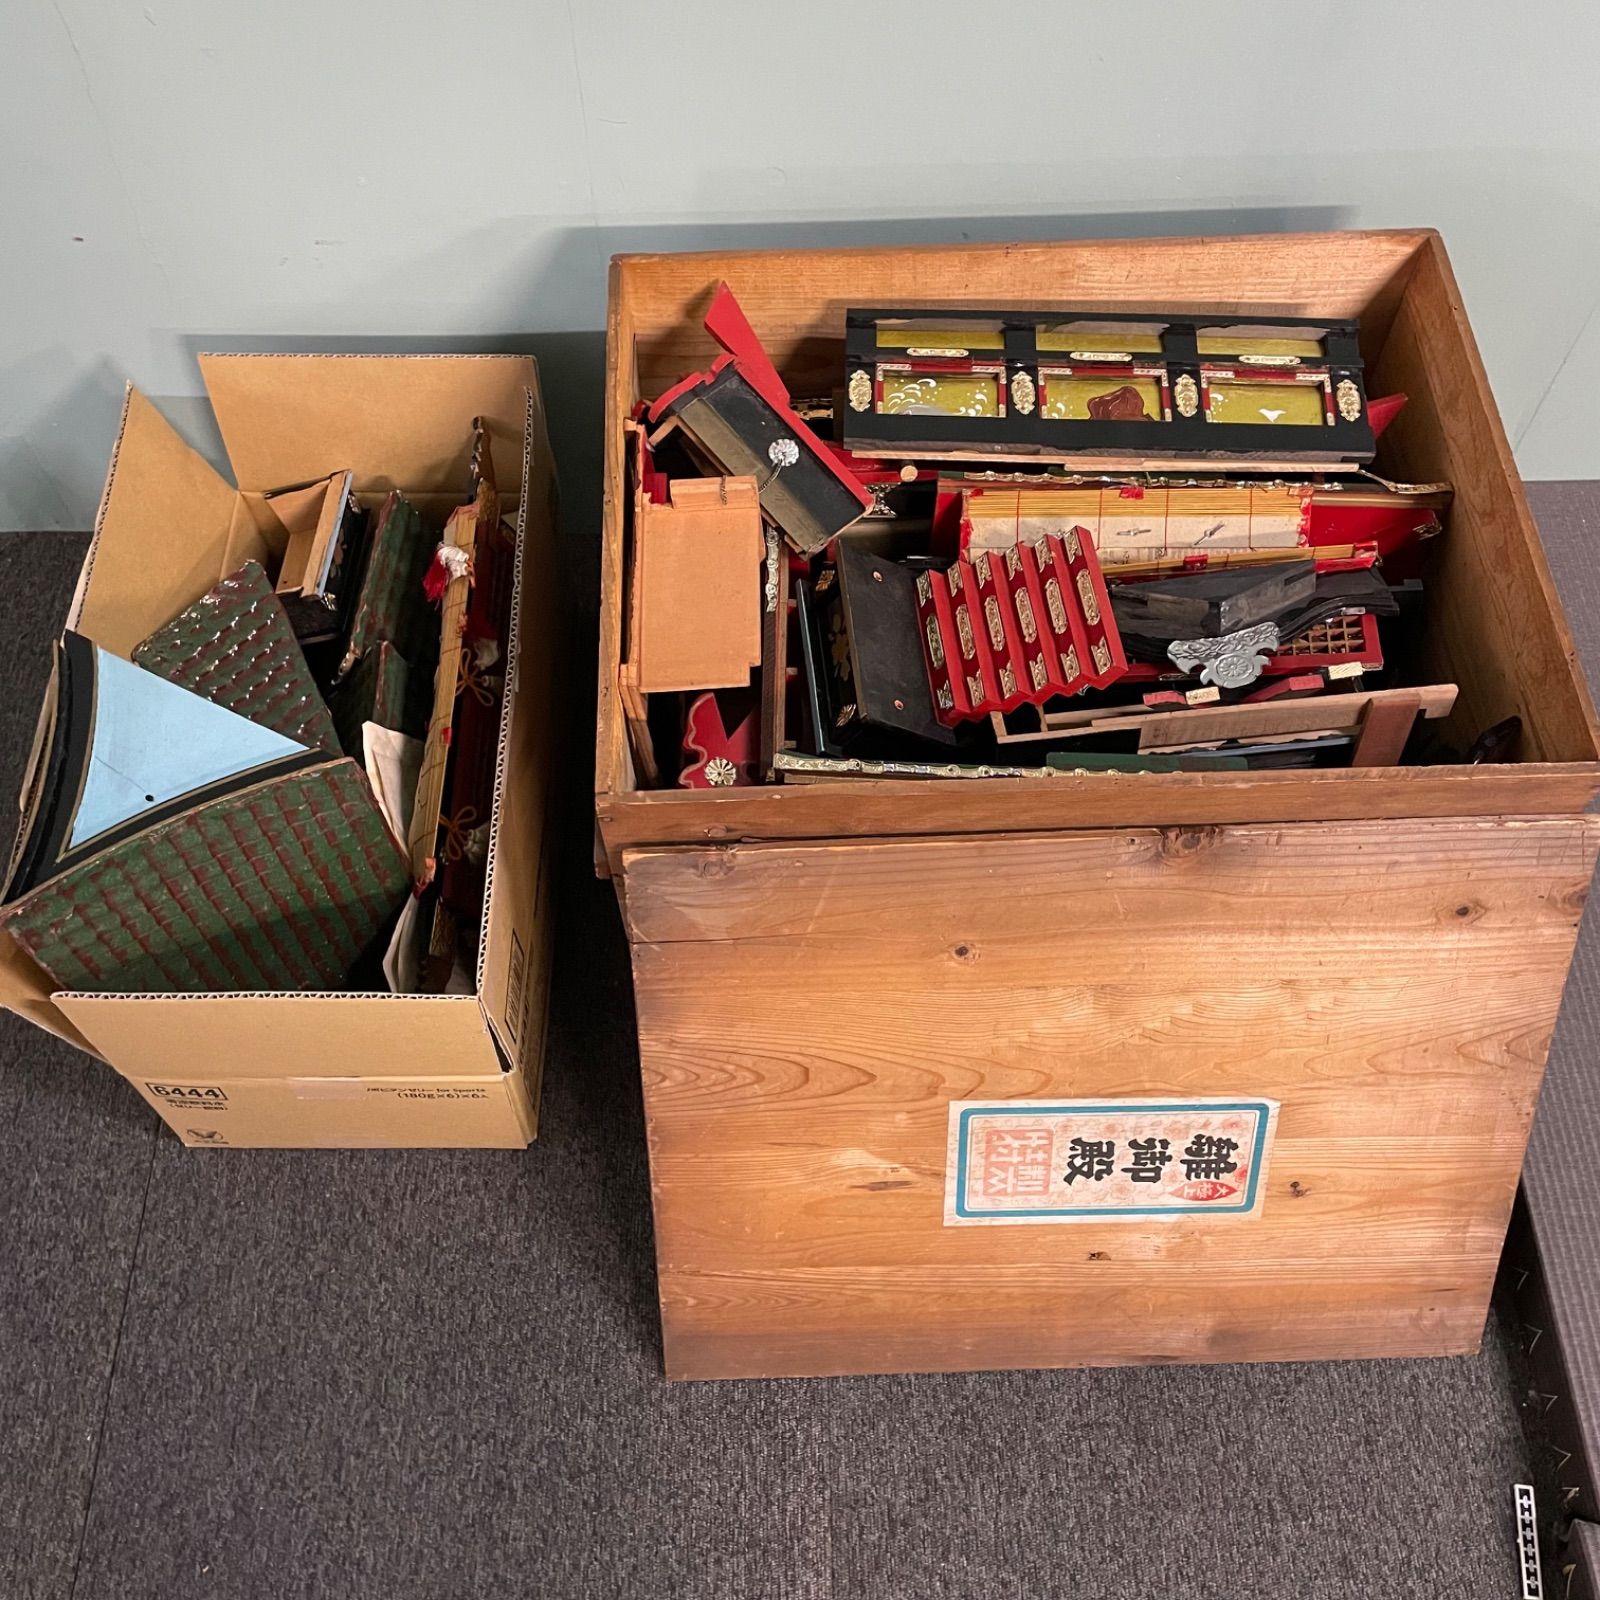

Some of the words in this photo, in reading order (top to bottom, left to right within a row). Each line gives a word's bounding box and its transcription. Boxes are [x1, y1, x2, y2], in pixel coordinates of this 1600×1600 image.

[153, 1086, 220, 1098] 6444
[1063, 1133, 1240, 1186] 雛御殿
